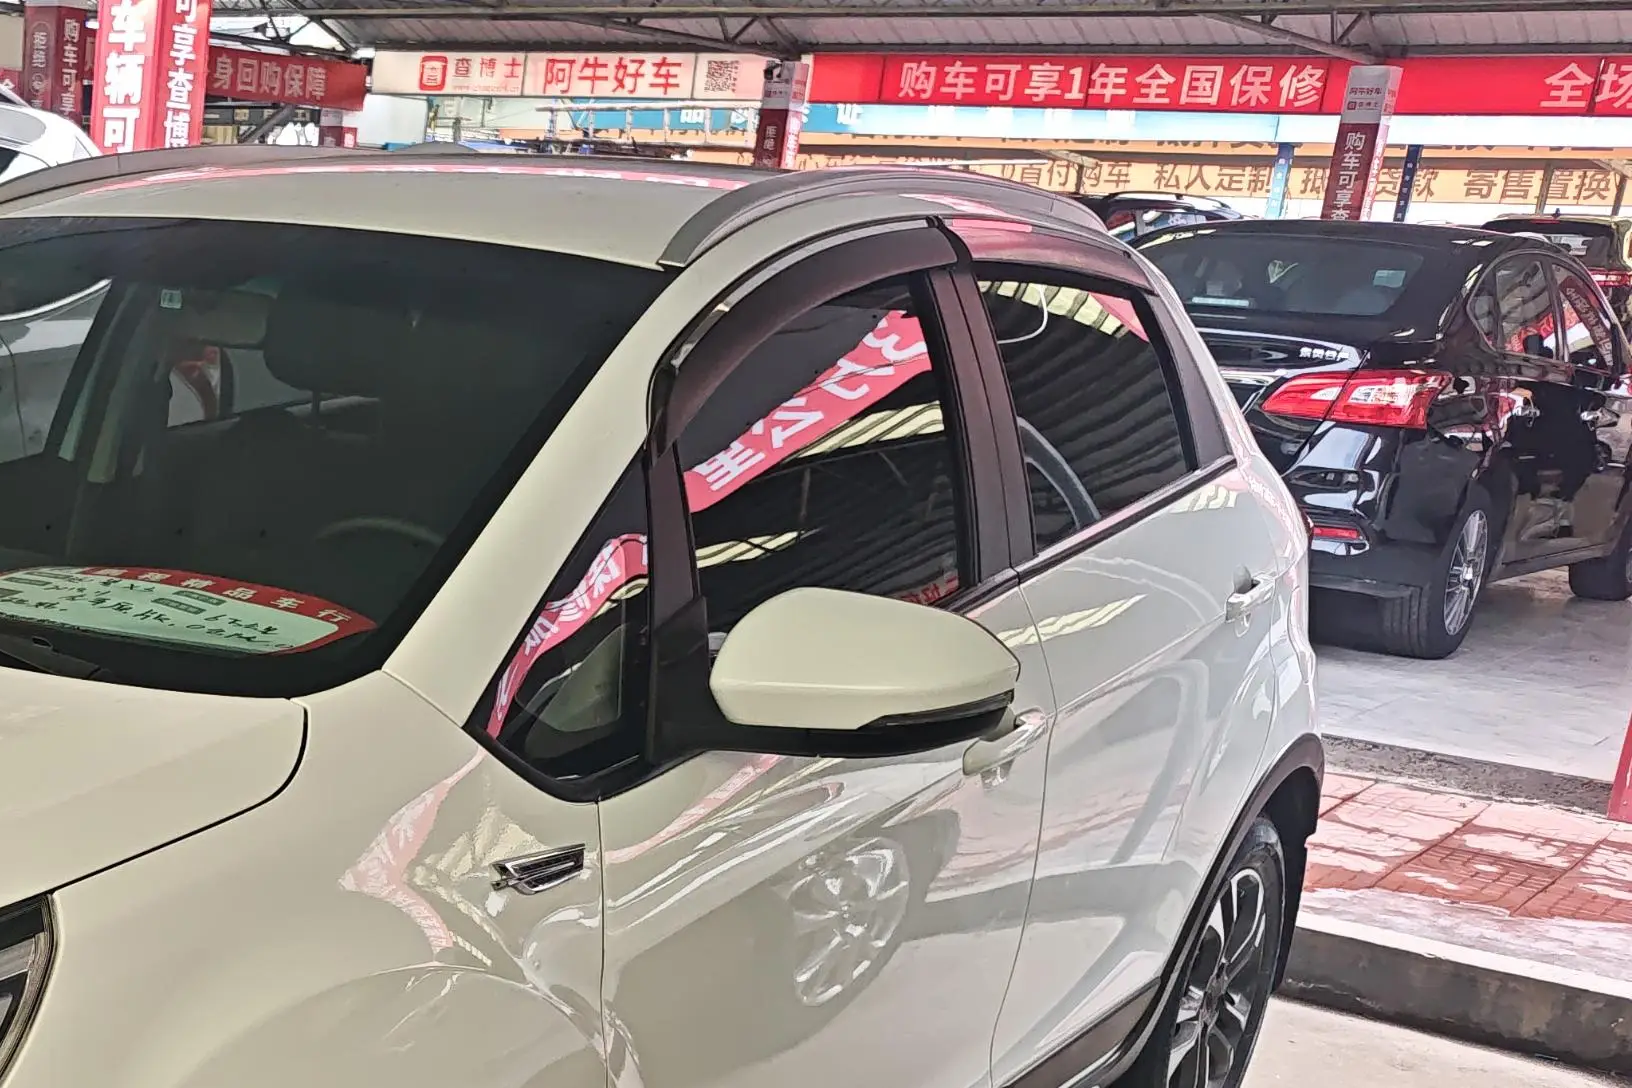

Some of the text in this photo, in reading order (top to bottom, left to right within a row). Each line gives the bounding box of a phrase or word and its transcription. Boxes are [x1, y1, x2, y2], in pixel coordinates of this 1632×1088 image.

[452, 57, 522, 79] 查博士
[543, 56, 682, 95] 阿牛好车
[898, 61, 1325, 108] 购车可享1年全国保修
[1154, 163, 1274, 194] 私人定制
[1300, 167, 1439, 197] 抵贷款
[1464, 169, 1611, 200] 寄售置换
